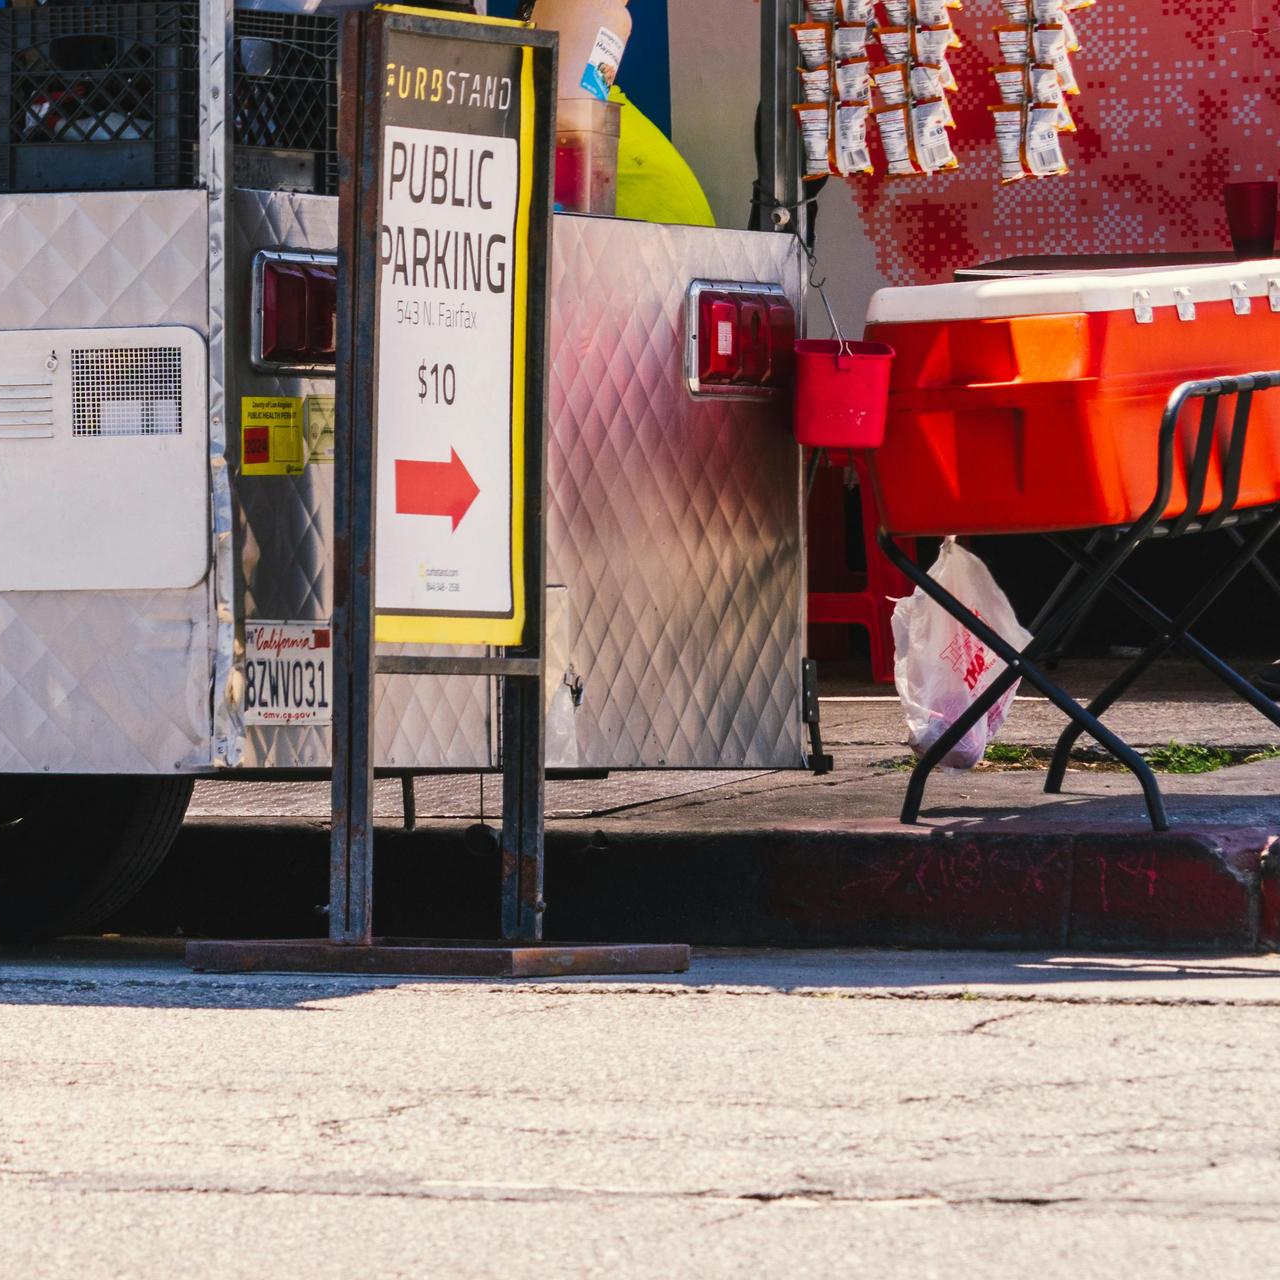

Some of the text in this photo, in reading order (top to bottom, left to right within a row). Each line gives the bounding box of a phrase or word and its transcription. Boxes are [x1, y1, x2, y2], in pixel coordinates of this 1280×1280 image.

[389, 141, 494, 210] PUBLIC
[382, 224, 506, 294] PARKING
[396, 300, 478, 329] 543 N. Fairfax
[418, 359, 456, 406] $10
[256, 626, 315, 657] California
[245, 661, 329, 708] 8ZWV031
